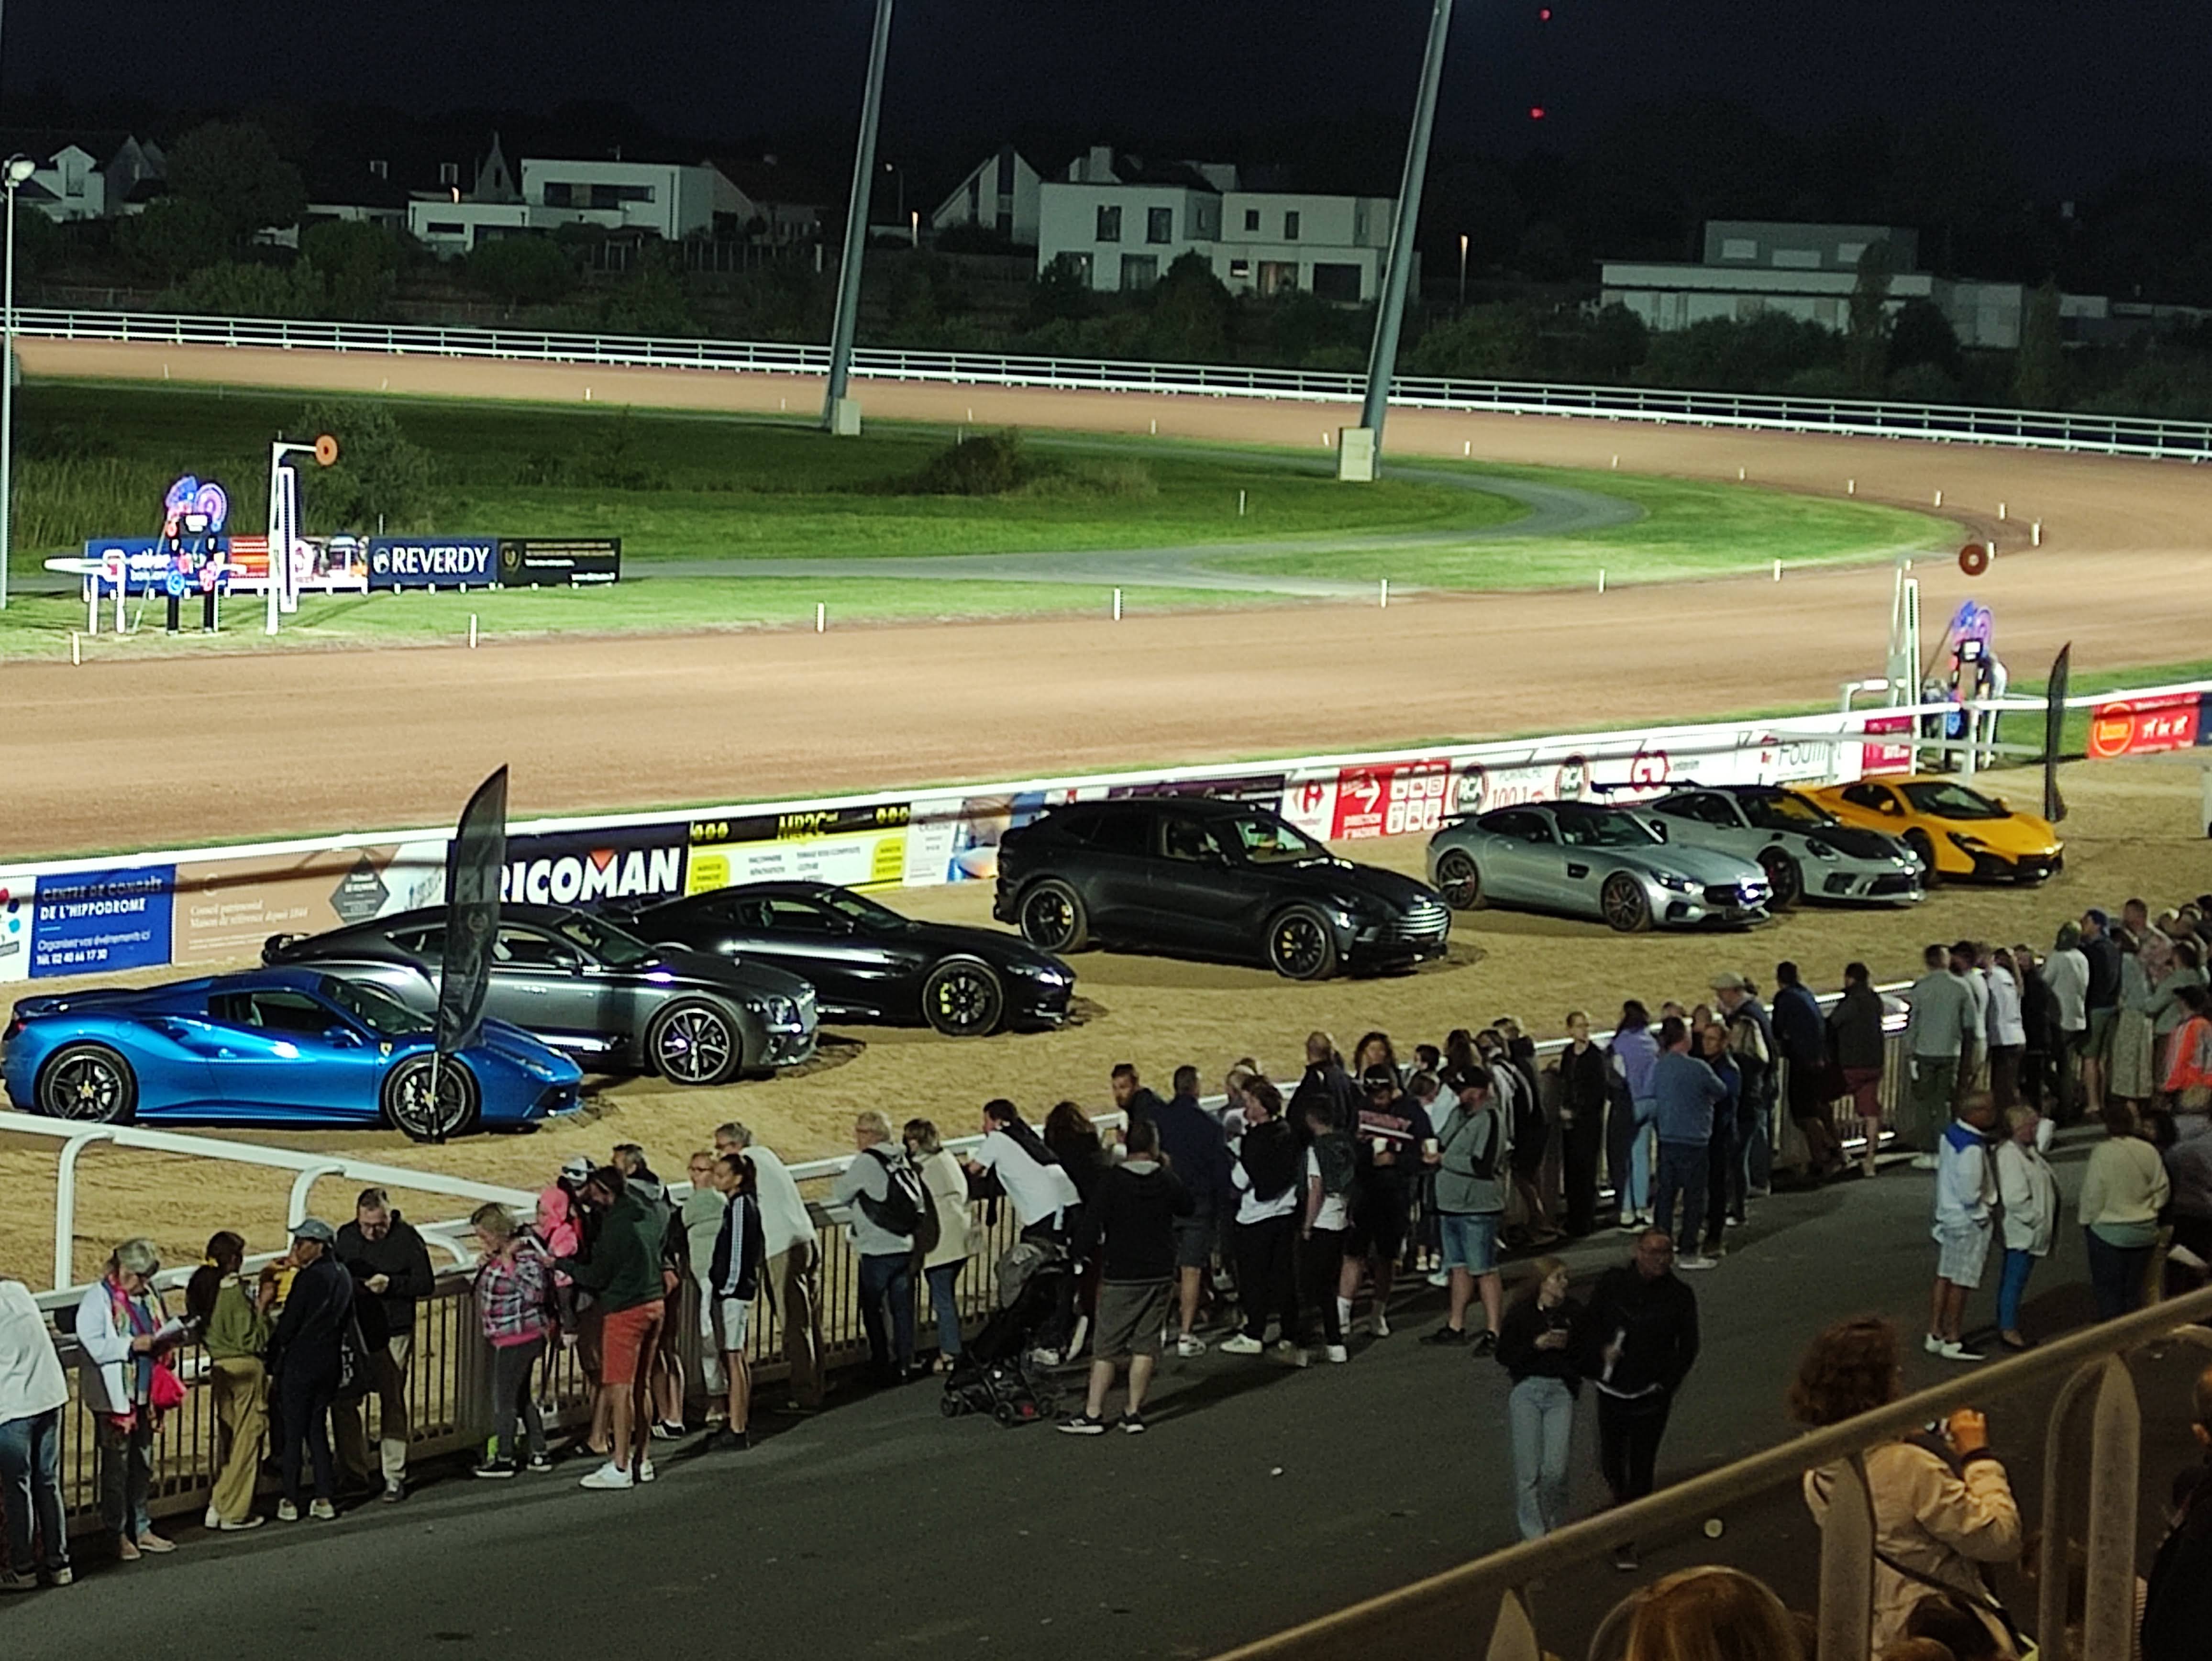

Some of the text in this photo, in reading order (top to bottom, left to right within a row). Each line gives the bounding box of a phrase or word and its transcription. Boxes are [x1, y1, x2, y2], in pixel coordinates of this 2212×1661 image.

[392, 547, 490, 574] REVERDY
[500, 847, 681, 905] RICOMAN
[89, 884, 105, 897] DE
[40, 897, 145, 920] DE L'HIPPODROME
